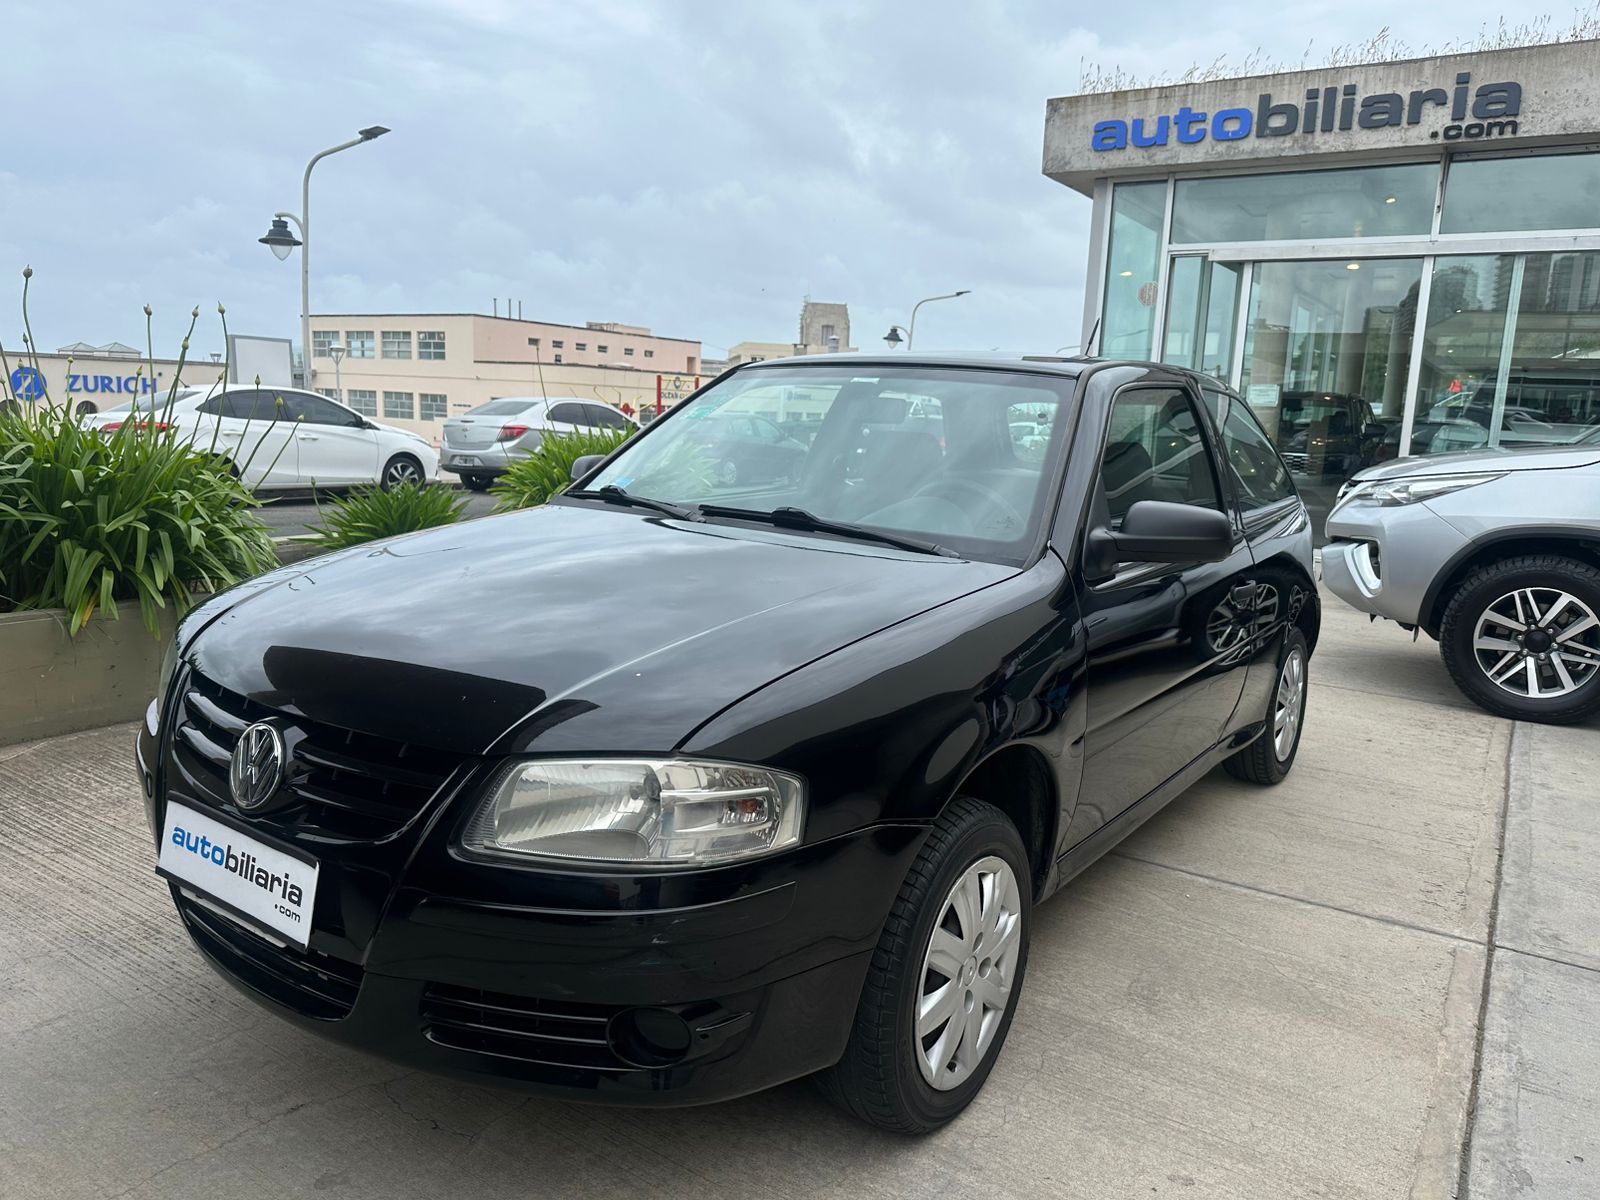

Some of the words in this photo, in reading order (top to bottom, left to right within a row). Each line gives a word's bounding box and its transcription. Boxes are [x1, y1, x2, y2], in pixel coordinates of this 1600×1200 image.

[1091, 72, 1522, 152] autobiliaria
[1430, 117, 1518, 139] .com
[66, 374, 157, 394] ZURICH
[171, 825, 304, 907] autobiliaria
[274, 903, 301, 923] .com
